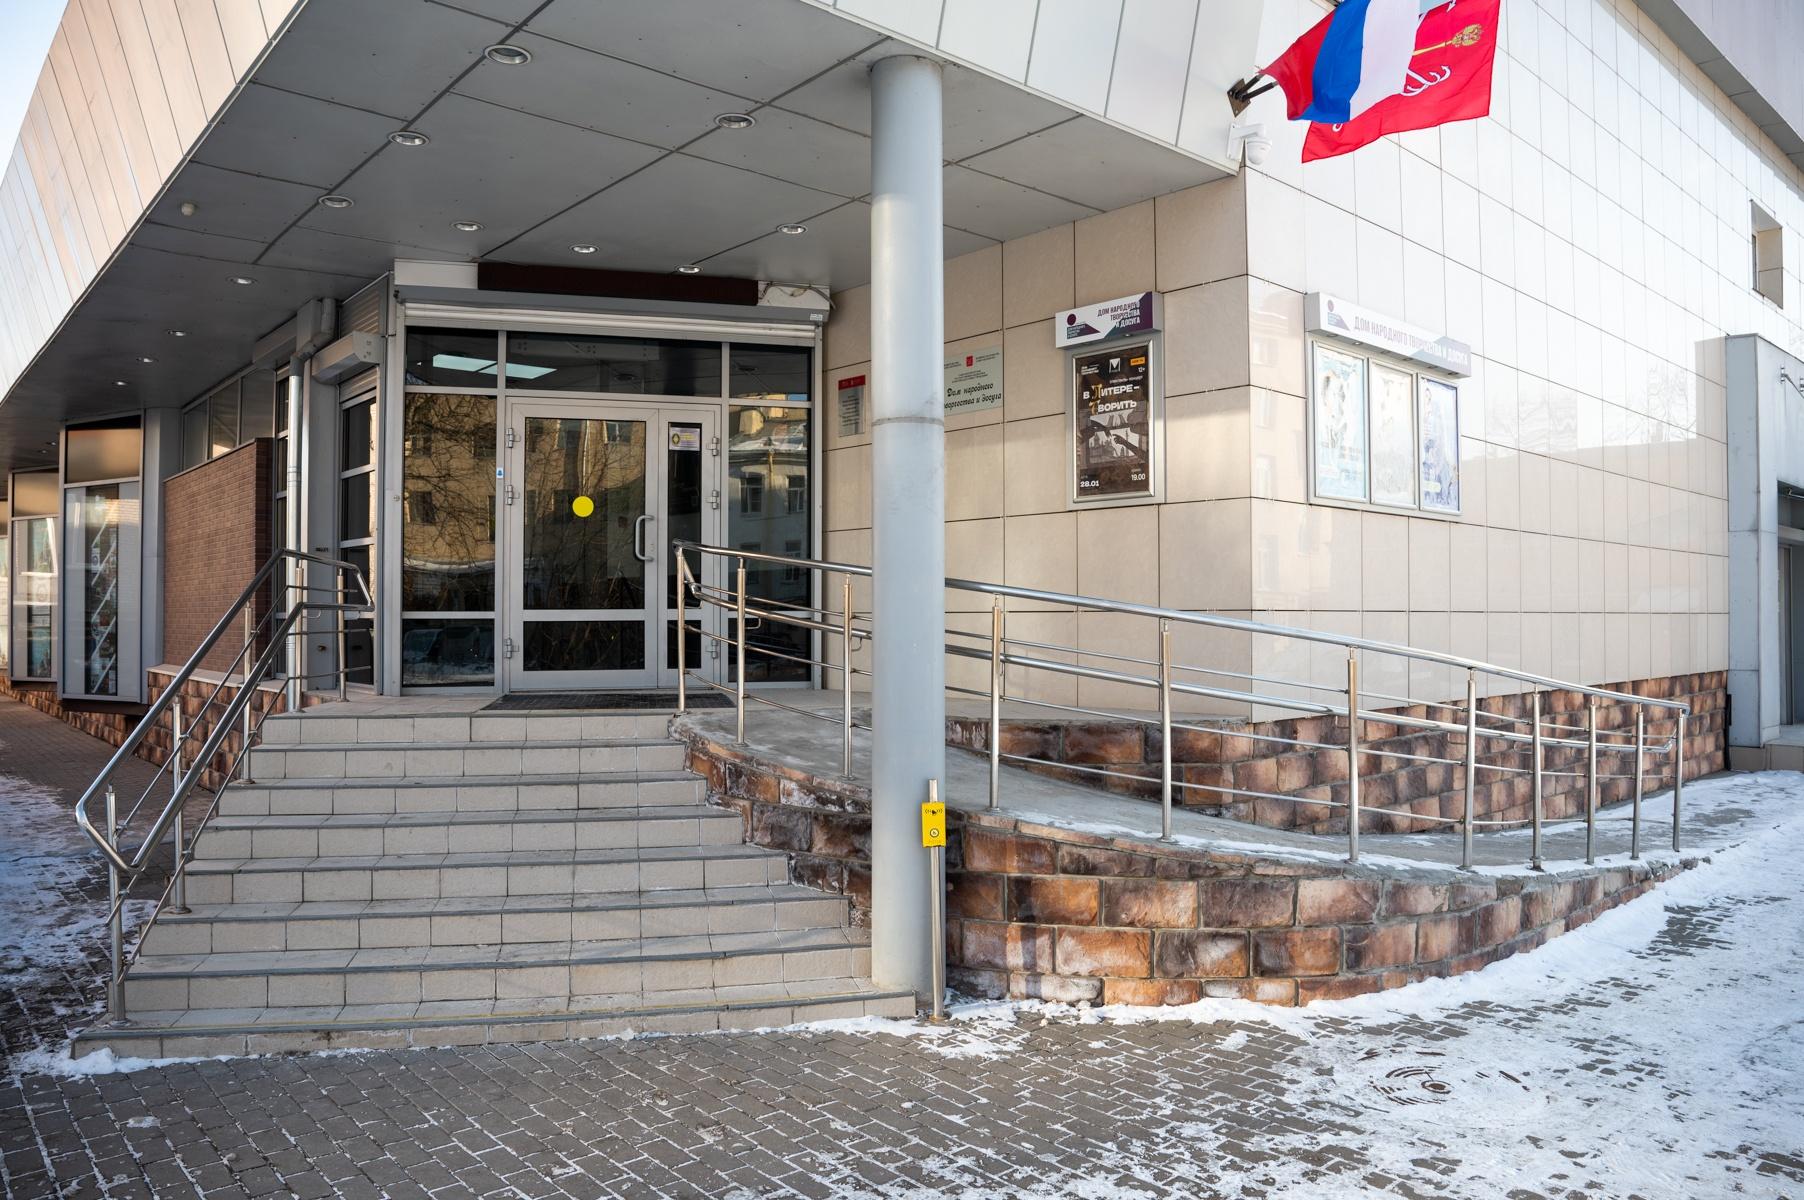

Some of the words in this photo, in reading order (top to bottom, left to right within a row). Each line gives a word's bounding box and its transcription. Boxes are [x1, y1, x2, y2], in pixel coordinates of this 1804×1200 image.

[1098, 307, 1110, 317] ДОМ
[1354, 316, 1370, 332] ДОМ
[1371, 323, 1408, 345] НАРОДНОГО
[947, 388, 961, 397] Дом
[964, 382, 994, 395] народного
[982, 393, 1002, 404] досуга
[1083, 391, 1090, 399] В
[1080, 480, 1100, 488] 28.01
